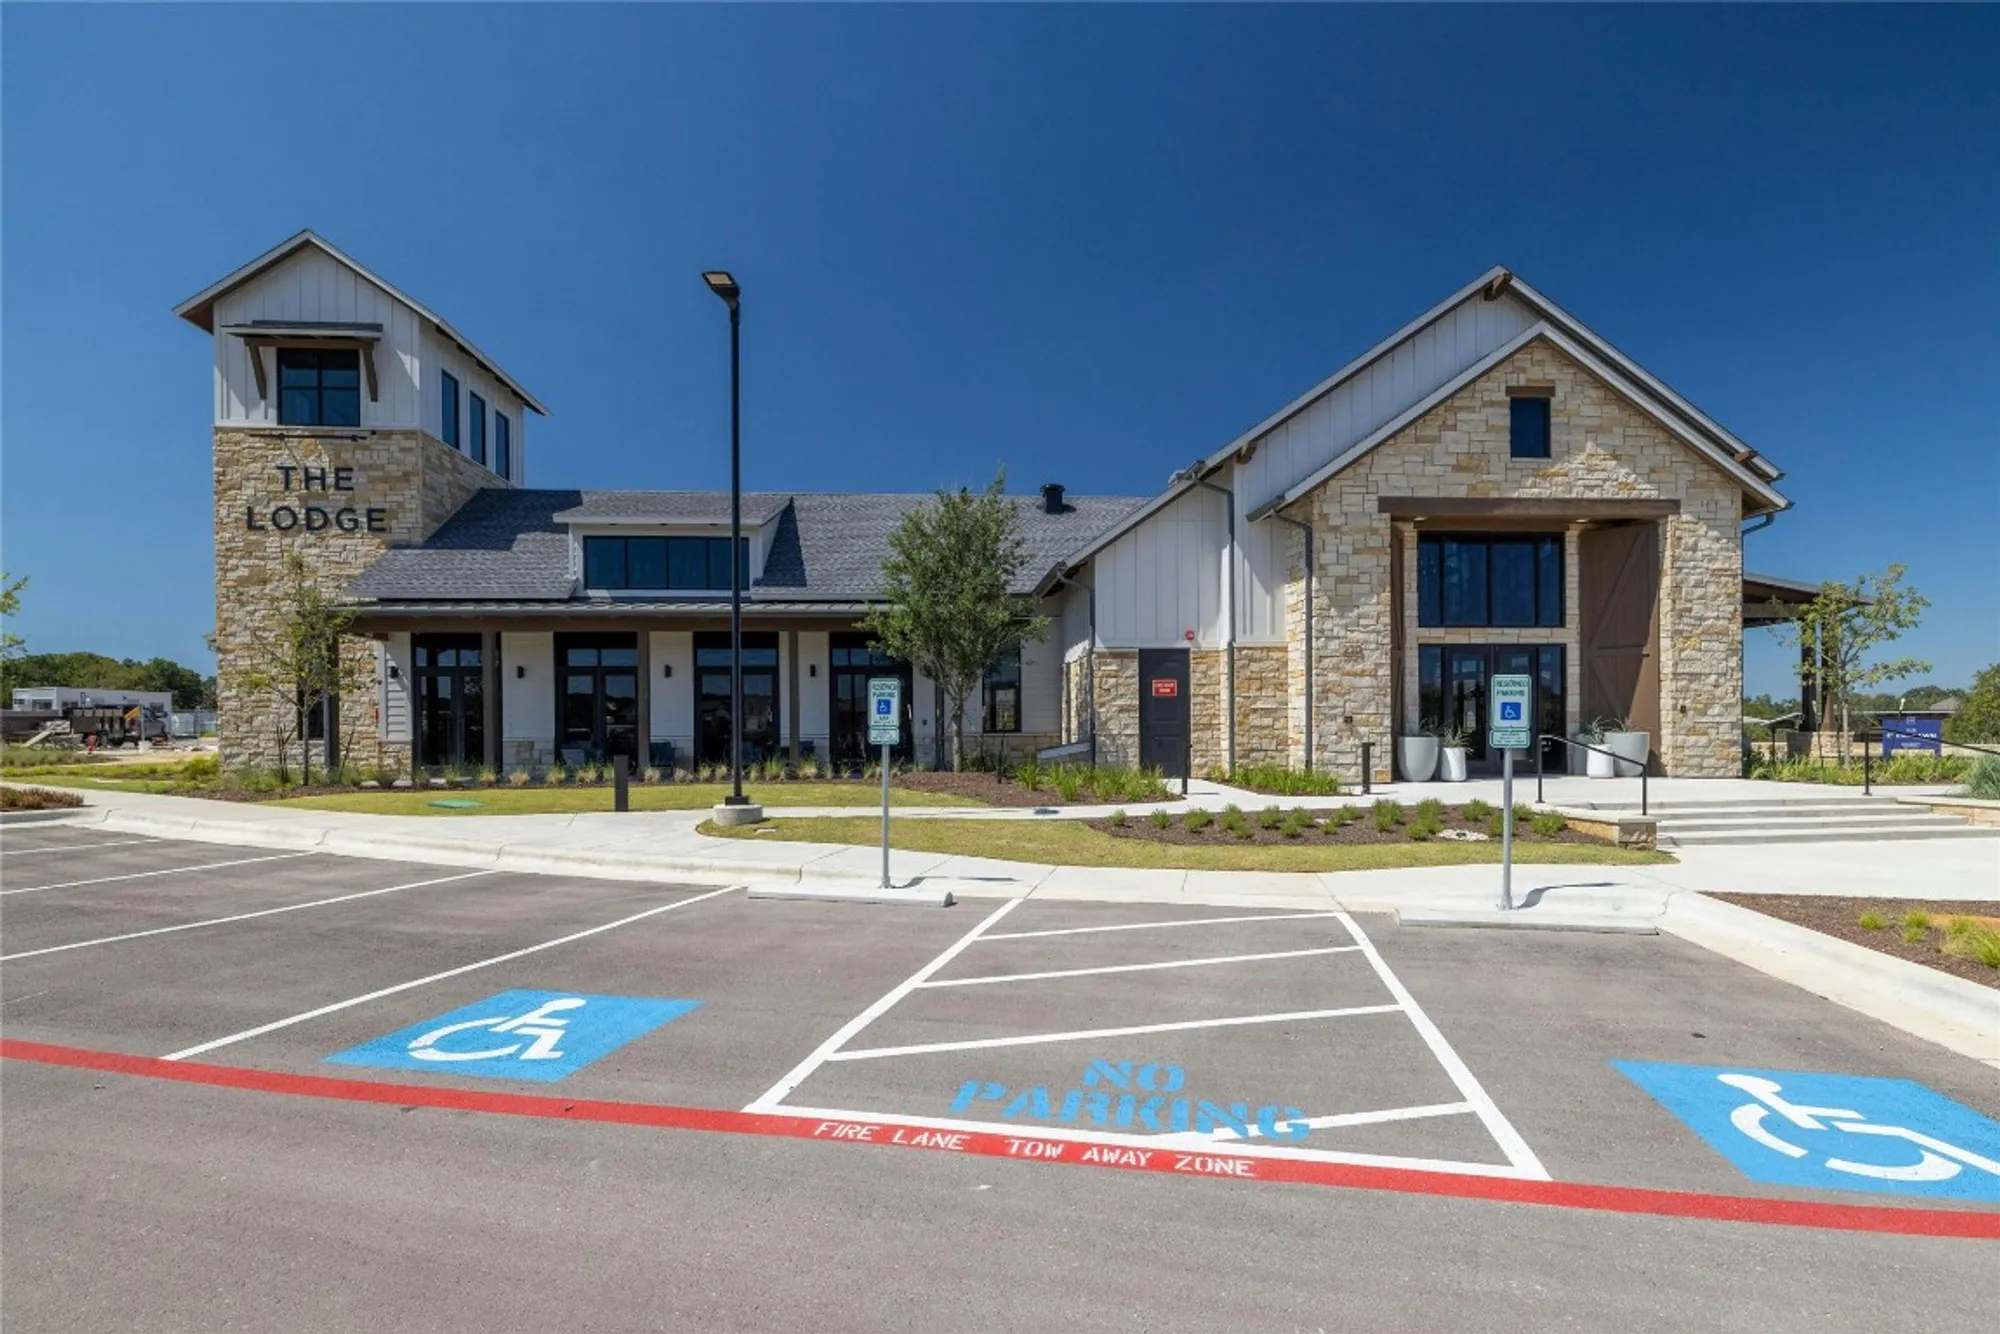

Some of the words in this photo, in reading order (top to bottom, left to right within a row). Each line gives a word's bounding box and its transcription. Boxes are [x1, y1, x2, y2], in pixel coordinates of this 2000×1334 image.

[276, 465, 354, 491] THE
[246, 506, 387, 532] LODGE
[1082, 1059, 1185, 1092] NO
[950, 1080, 1310, 1141] PARKING
[813, 1121, 880, 1141] FIRE
[892, 1129, 970, 1151] LANE
[1009, 1138, 1064, 1158] TOW
[1082, 1146, 1153, 1168] AWAY
[1174, 1154, 1255, 1177] ZONE
